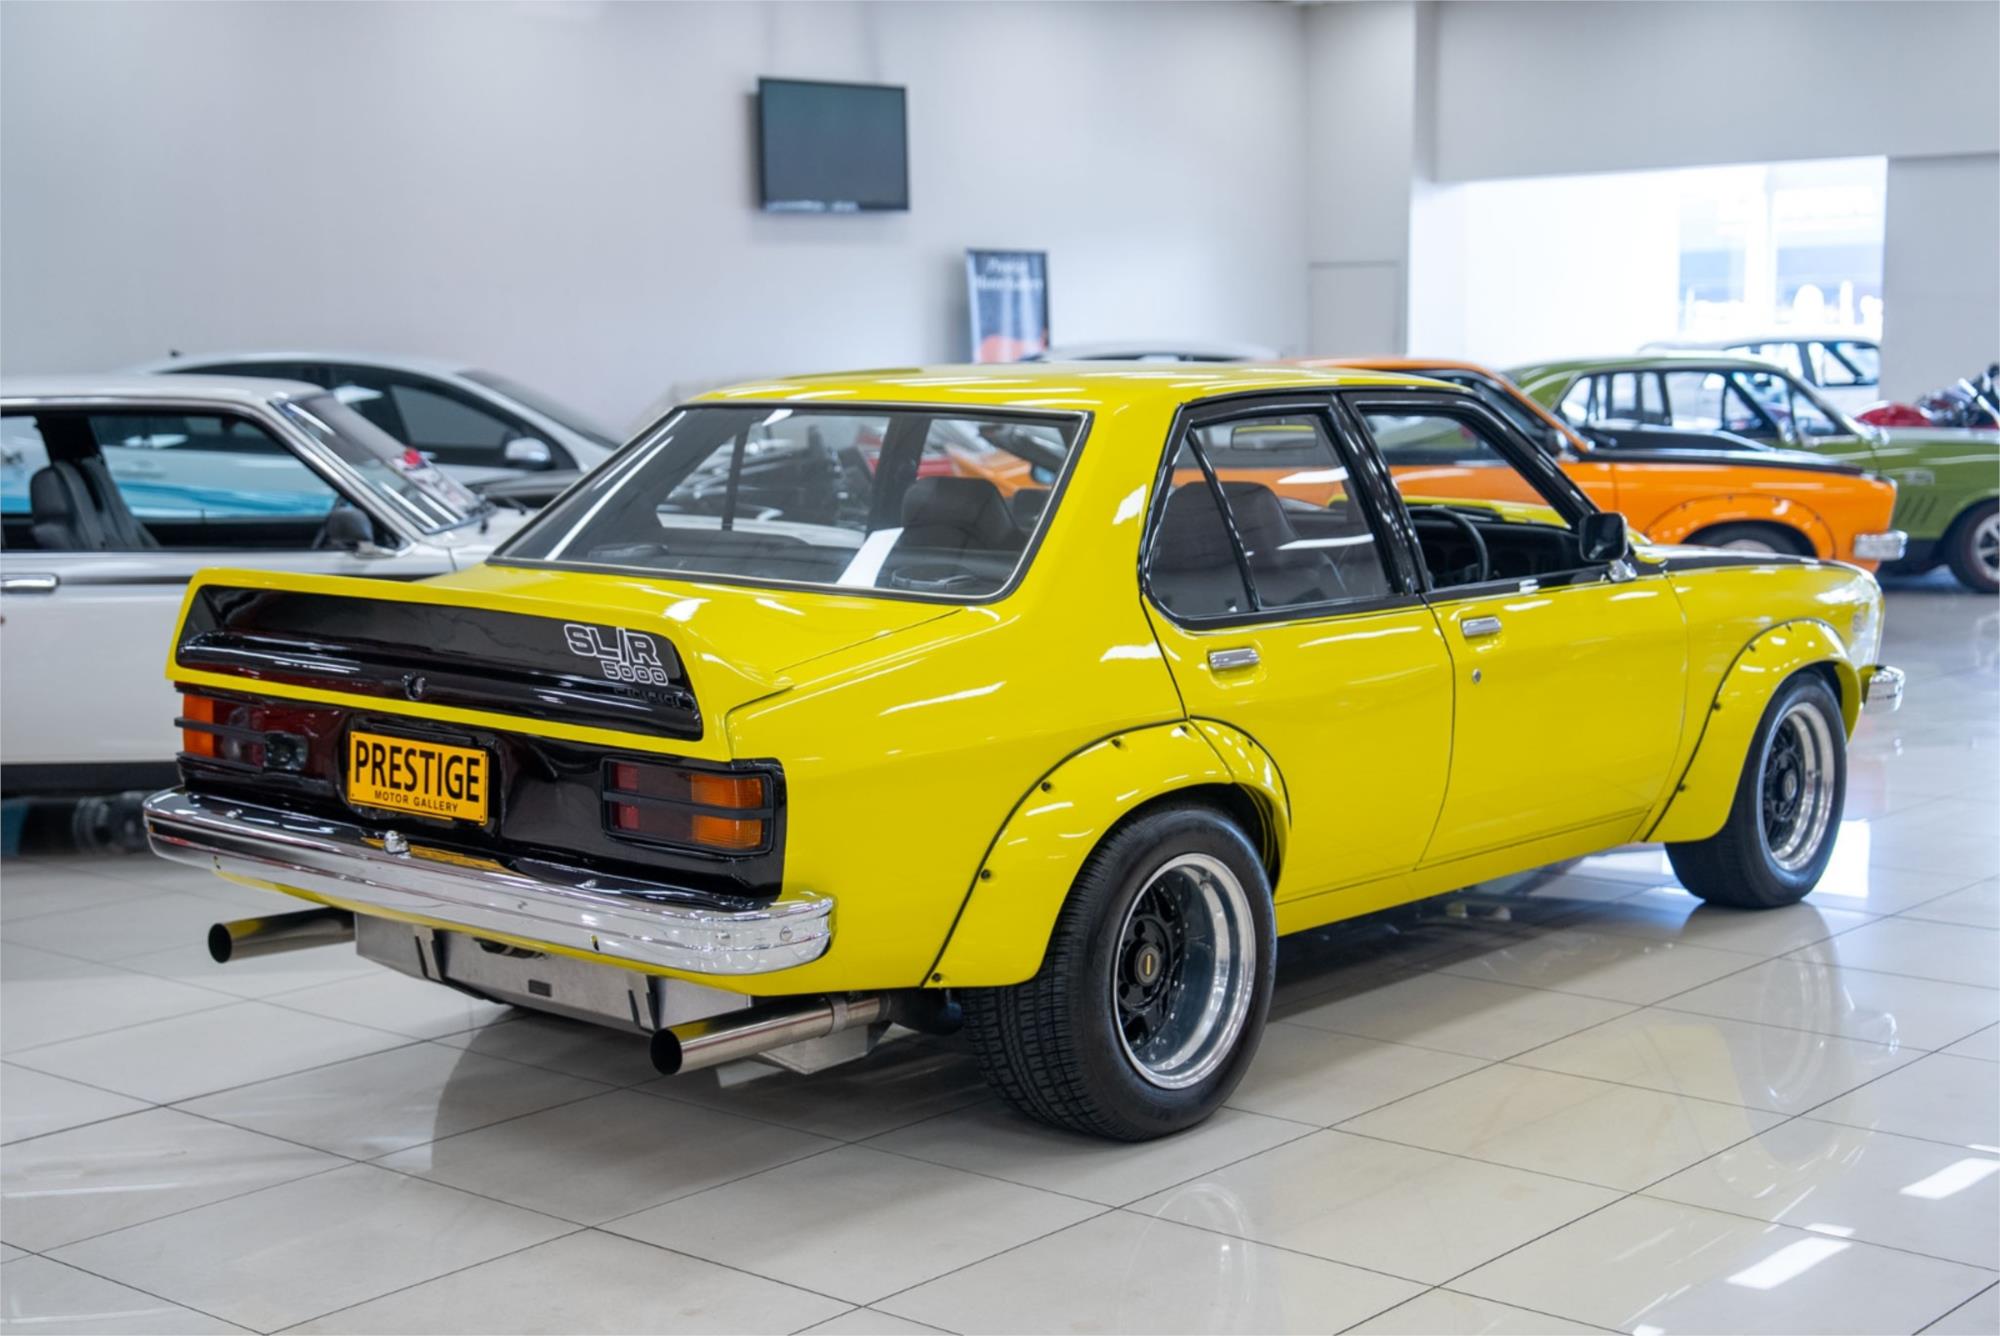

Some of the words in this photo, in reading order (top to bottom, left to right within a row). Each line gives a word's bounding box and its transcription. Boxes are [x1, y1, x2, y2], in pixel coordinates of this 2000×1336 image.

[564, 623, 662, 667] SL/R
[600, 660, 668, 686] 5000
[355, 739, 480, 803] PRESTIGE
[374, 790, 409, 805] MOTOR
[413, 796, 459, 813] GALLERY
